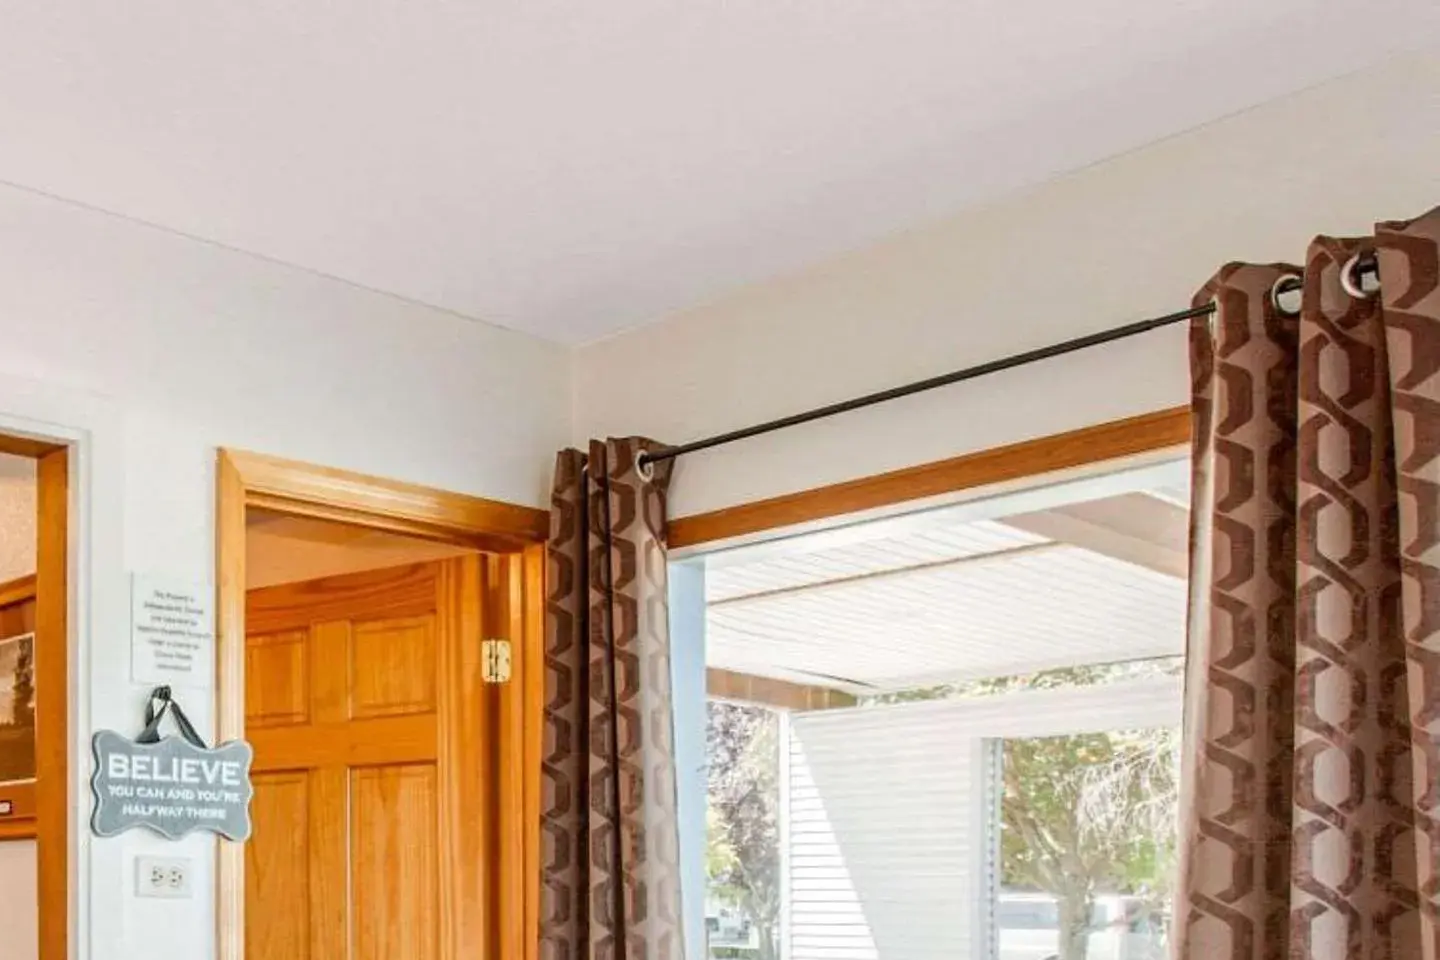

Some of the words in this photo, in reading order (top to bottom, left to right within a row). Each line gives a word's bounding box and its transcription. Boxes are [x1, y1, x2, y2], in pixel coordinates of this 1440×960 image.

[108, 753, 241, 786] BELIEVE
[108, 785, 134, 797] YOU
[136, 786, 164, 799] CAN
[167, 788, 195, 800] AND
[122, 803, 185, 818] HALFWAY
[186, 806, 227, 820] THERE
